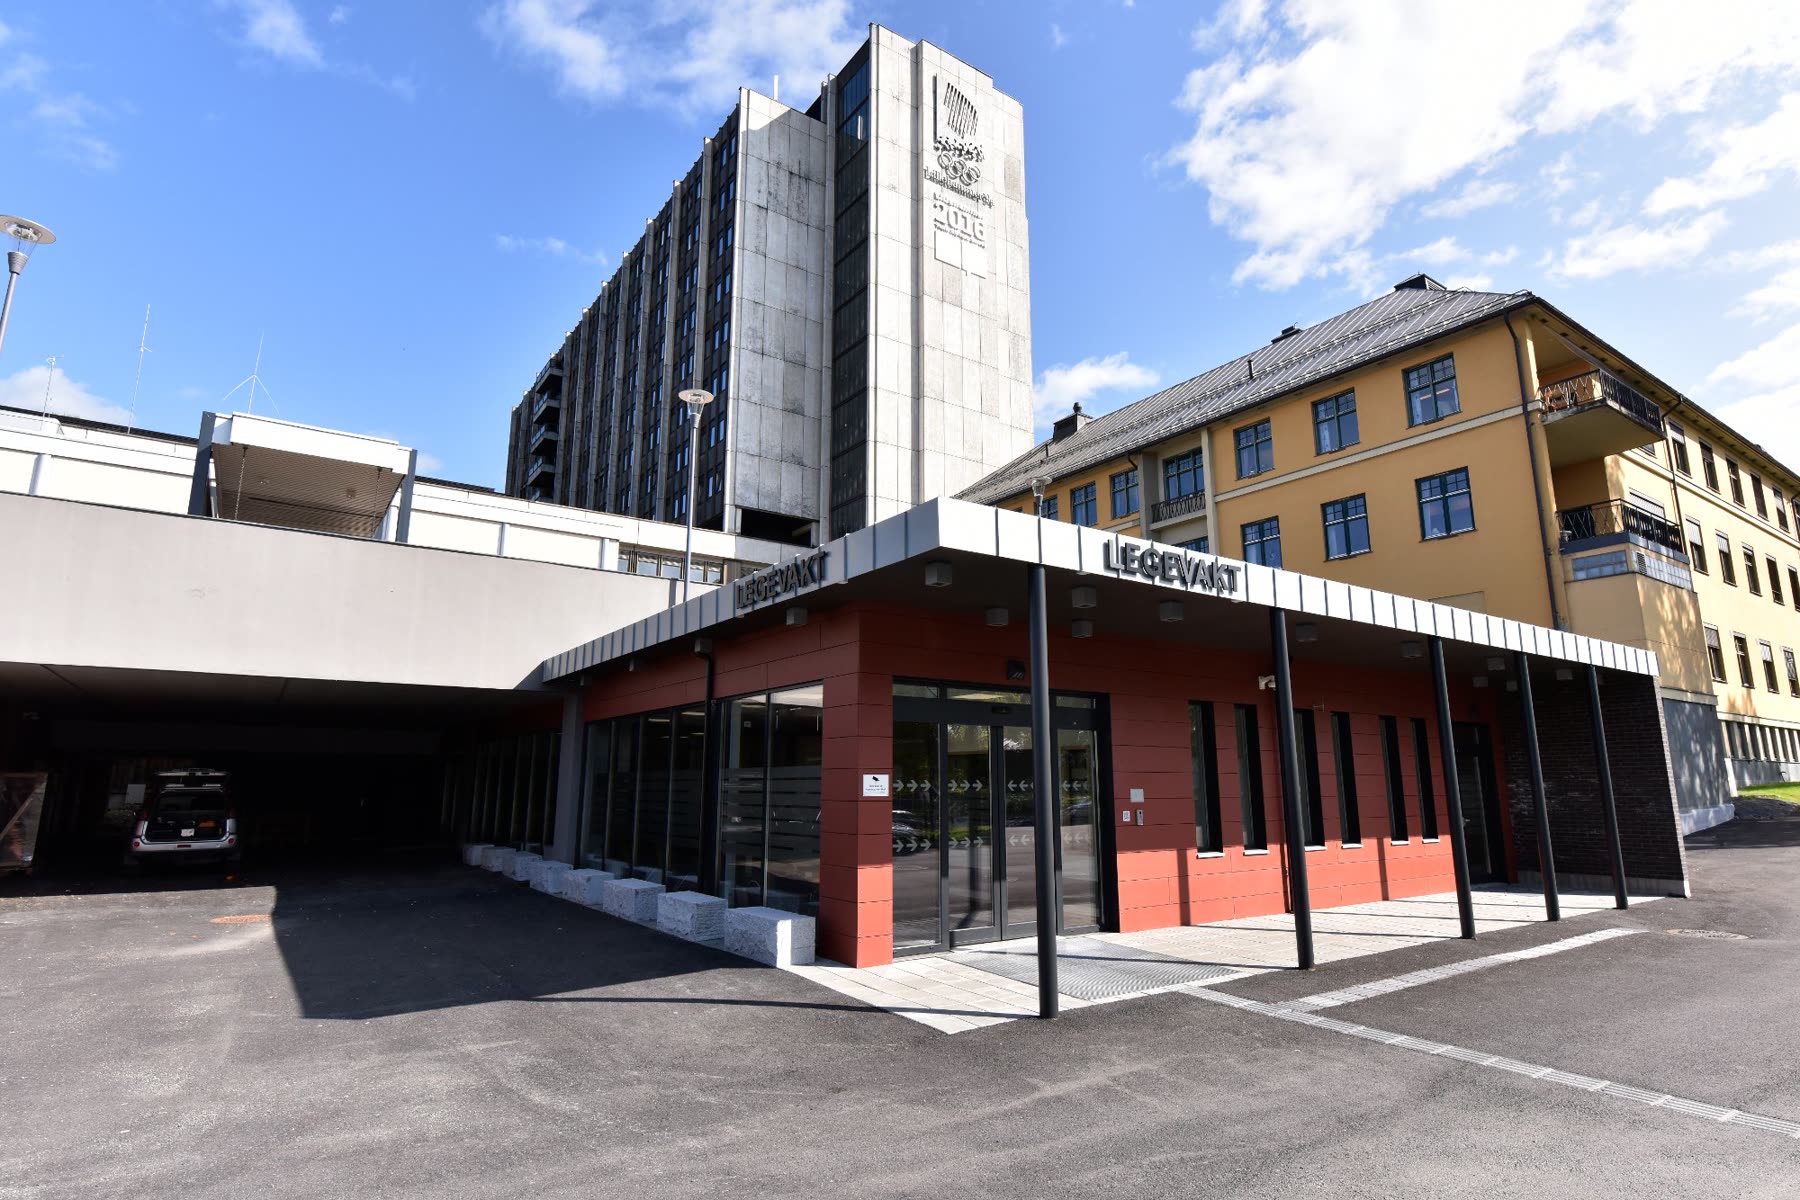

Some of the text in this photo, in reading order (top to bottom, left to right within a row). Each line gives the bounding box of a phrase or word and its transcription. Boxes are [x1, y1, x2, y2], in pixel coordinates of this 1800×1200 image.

[933, 203, 985, 241] 2016
[736, 550, 828, 609] LEGEVAKT
[1104, 539, 1241, 594] LEGEVAKT
